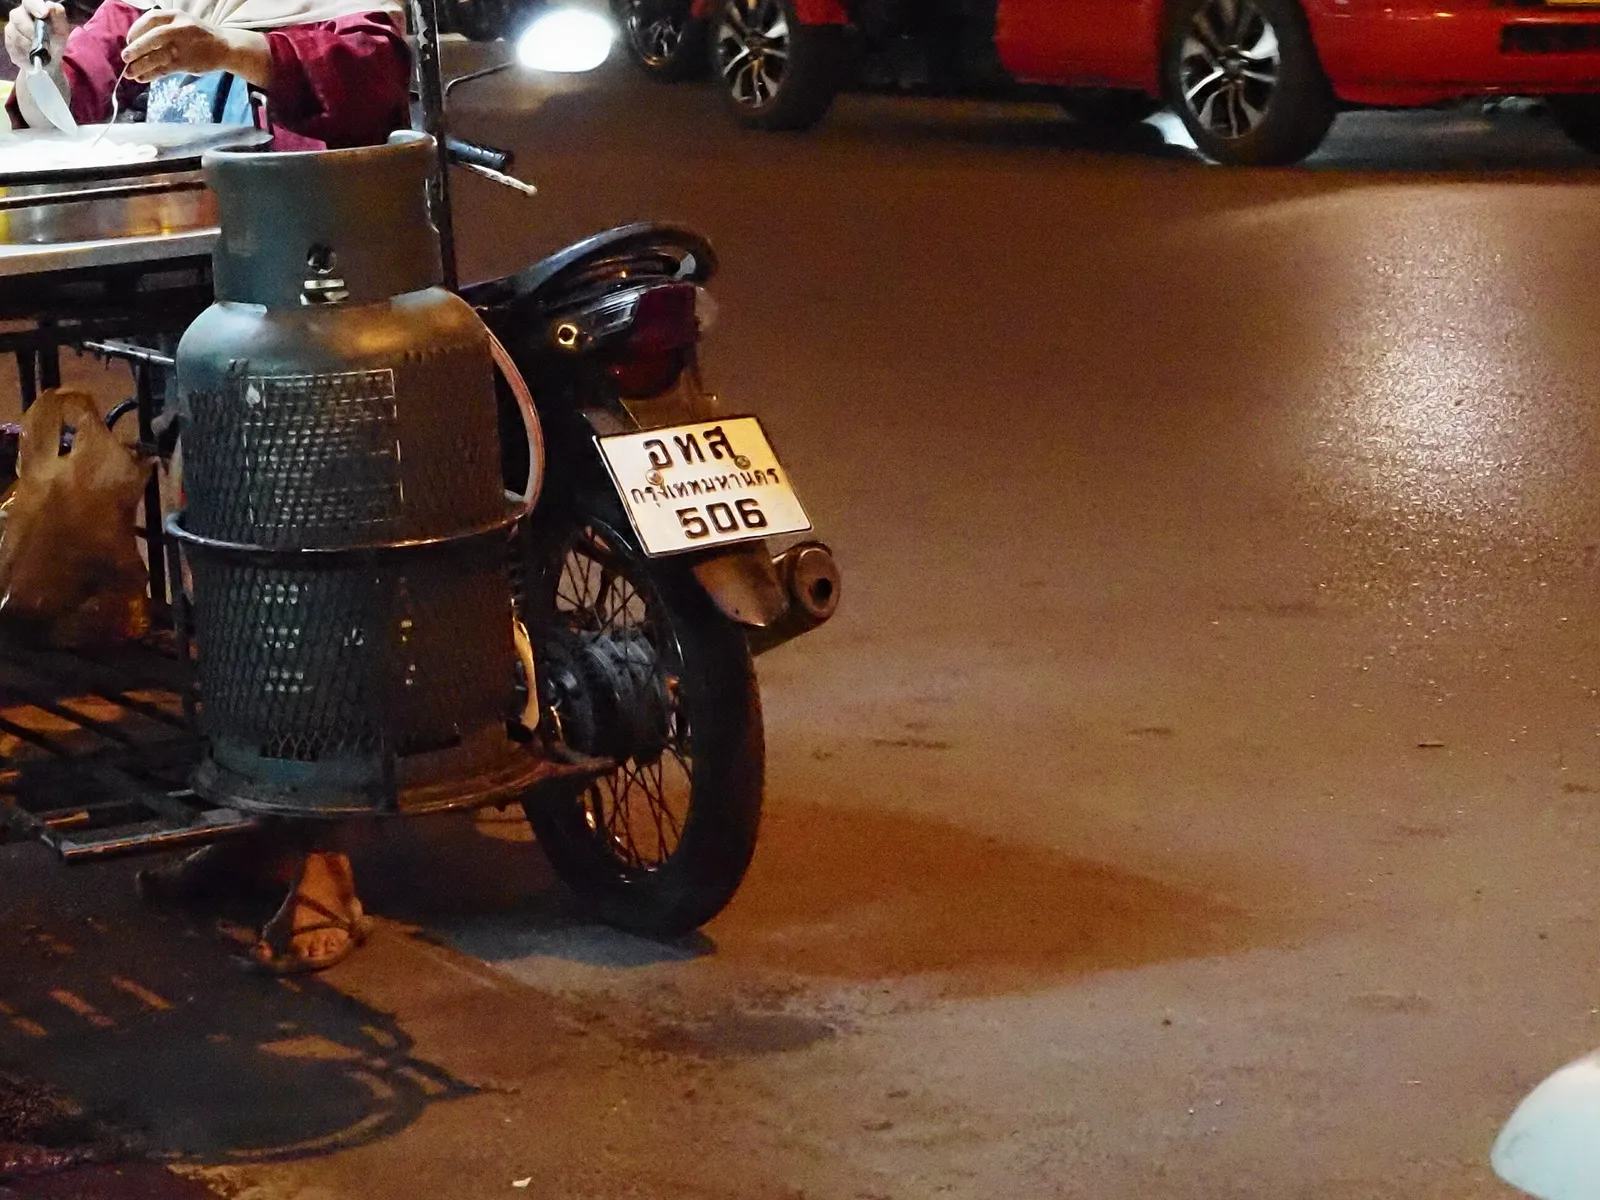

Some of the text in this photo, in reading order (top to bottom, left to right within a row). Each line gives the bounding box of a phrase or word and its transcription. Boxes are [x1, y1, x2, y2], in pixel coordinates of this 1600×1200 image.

[630, 467, 781, 508] กรุงเทพมหานคร
[675, 497, 768, 540] 506
